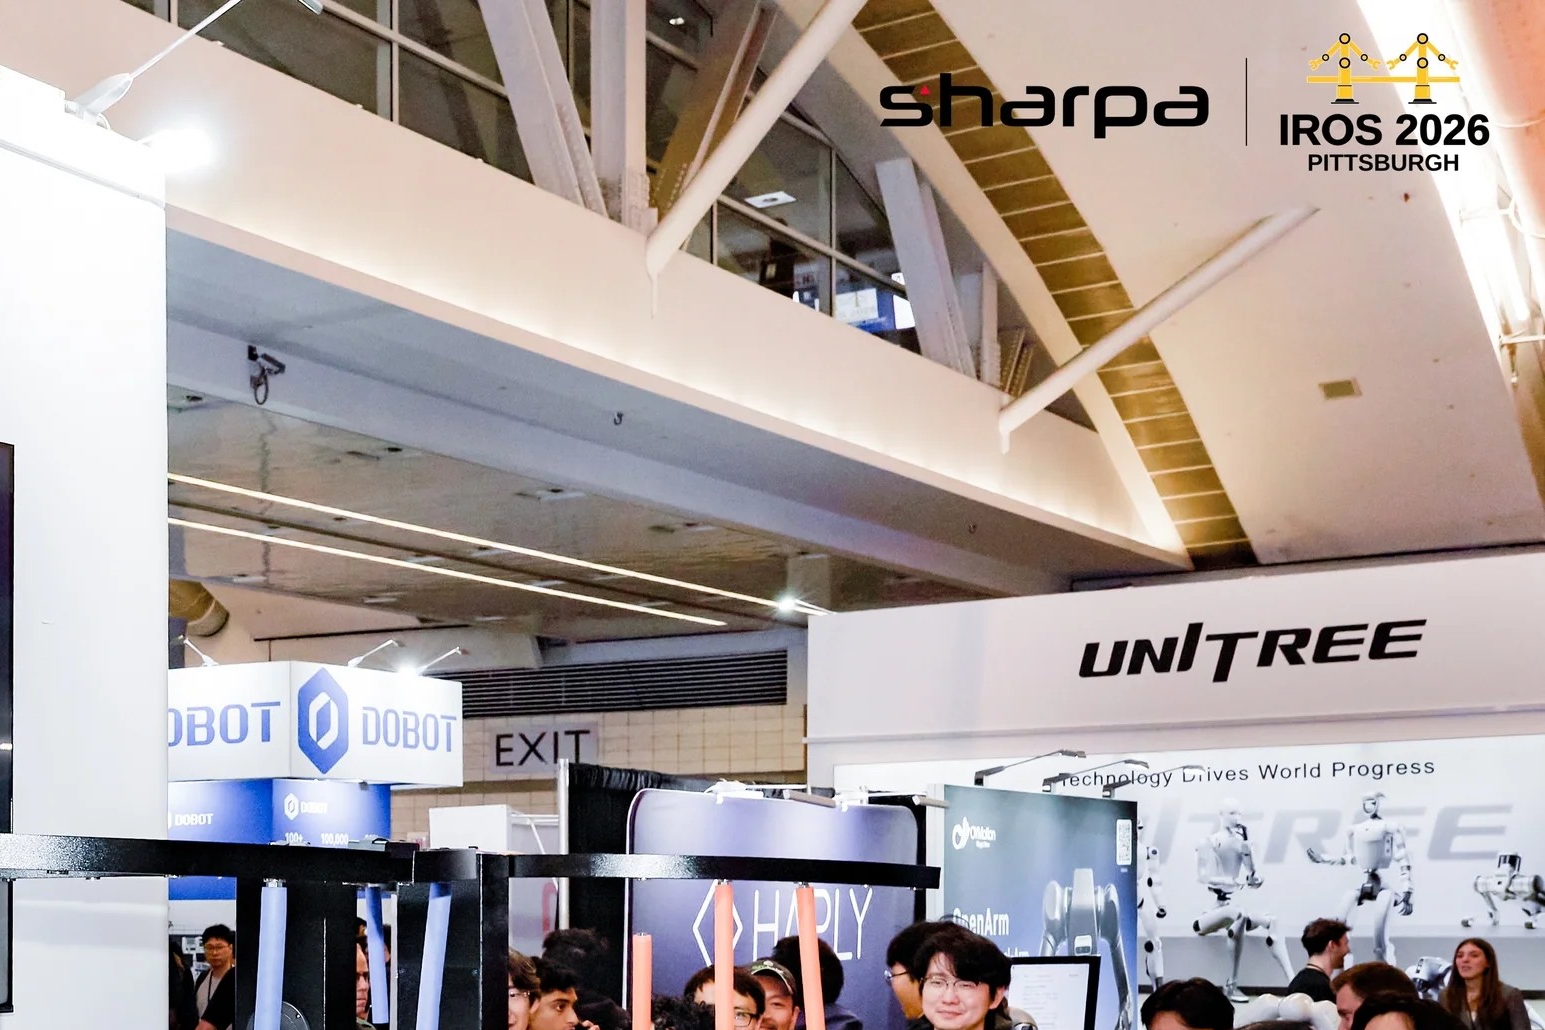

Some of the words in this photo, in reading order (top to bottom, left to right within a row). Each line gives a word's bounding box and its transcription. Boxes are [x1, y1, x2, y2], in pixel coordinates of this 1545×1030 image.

[1078, 618, 1427, 682] UNITREE
[168, 701, 281, 747] OBOT
[362, 706, 457, 752] DOBOT
[496, 729, 590, 767] EXIT
[1062, 769, 1172, 788] Technology
[1258, 762, 1321, 781] World
[1332, 760, 1435, 782] Progress
[175, 813, 213, 826] DOBOT
